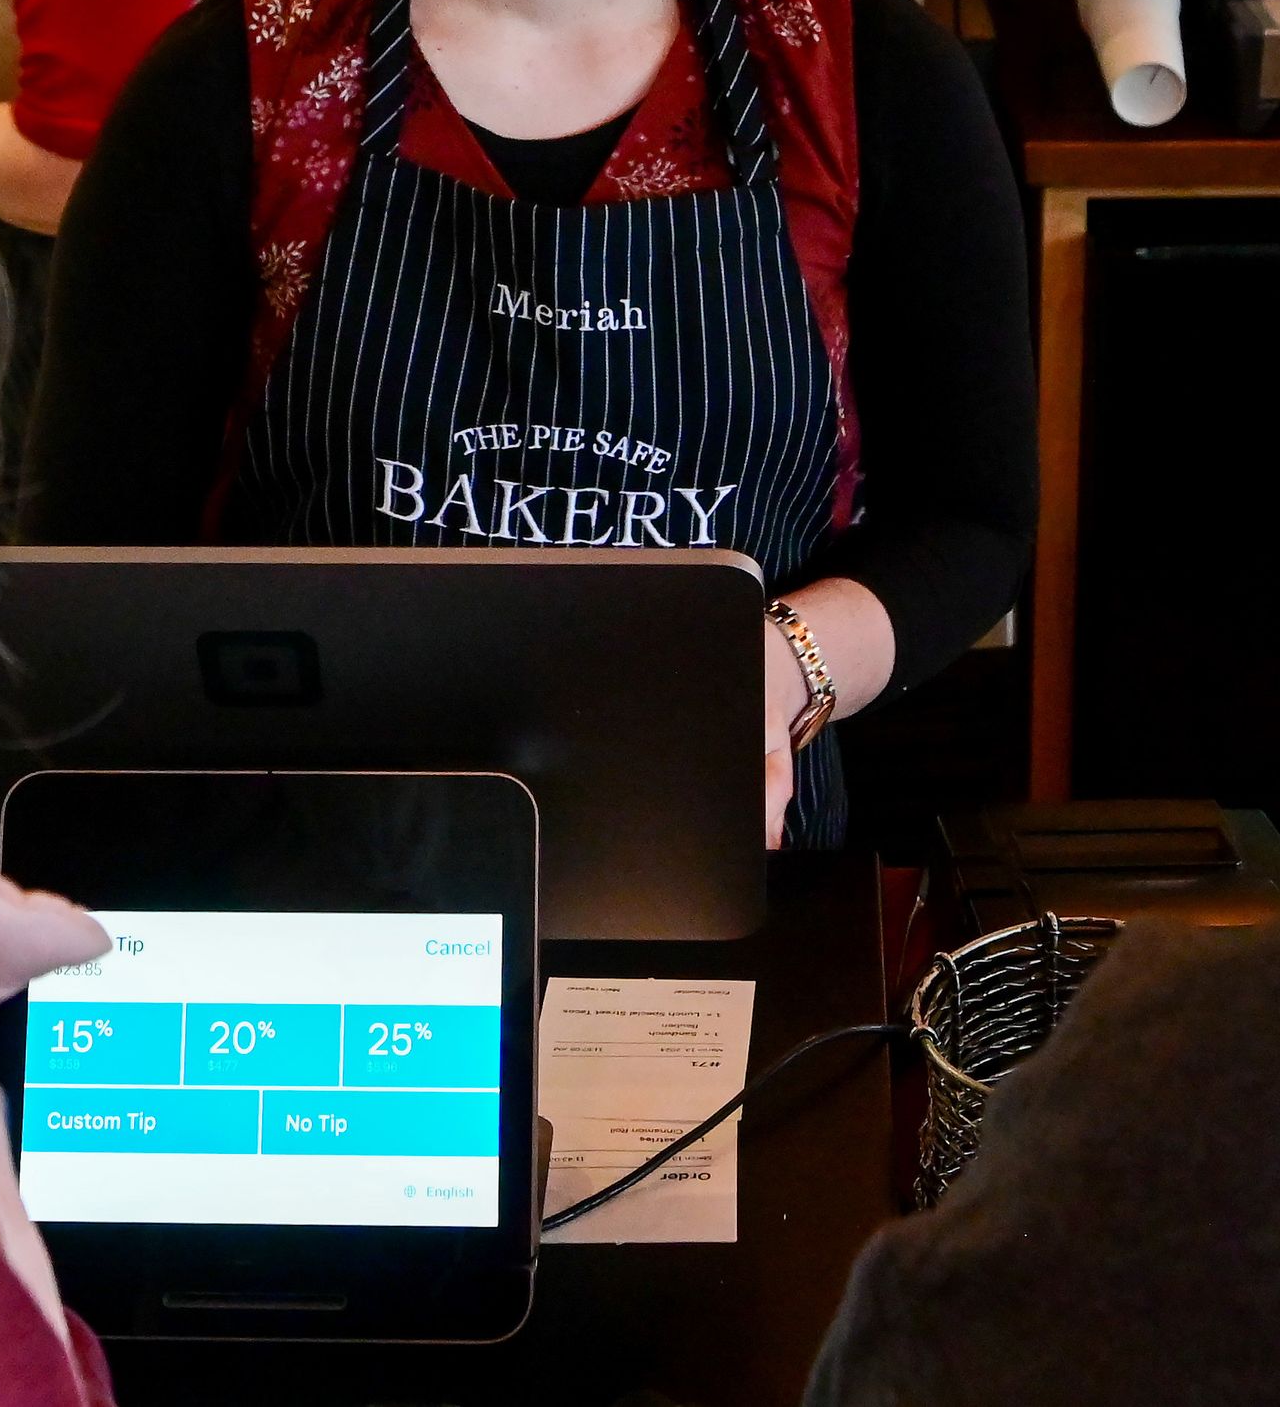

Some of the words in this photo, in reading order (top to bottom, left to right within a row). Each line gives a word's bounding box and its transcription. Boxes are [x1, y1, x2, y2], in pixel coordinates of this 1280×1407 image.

[491, 283, 647, 332] Meriah
[453, 423, 523, 458] THE
[528, 424, 586, 455] PIE
[592, 429, 672, 476] SAFE
[375, 457, 738, 548] BAKERY
[115, 935, 145, 956] Tip
[424, 939, 491, 957] Cancel
[50, 1018, 114, 1054] 15%
[208, 1020, 277, 1056] 20%
[367, 1021, 434, 1057] 25%
[46, 1111, 121, 1131] Custom
[126, 1112, 157, 1134] Tip
[285, 1114, 313, 1134] No
[318, 1113, 349, 1137] Tip
[639, 1135, 676, 1144] astries
[659, 1171, 712, 1182] Order
[424, 1184, 475, 1200] English
